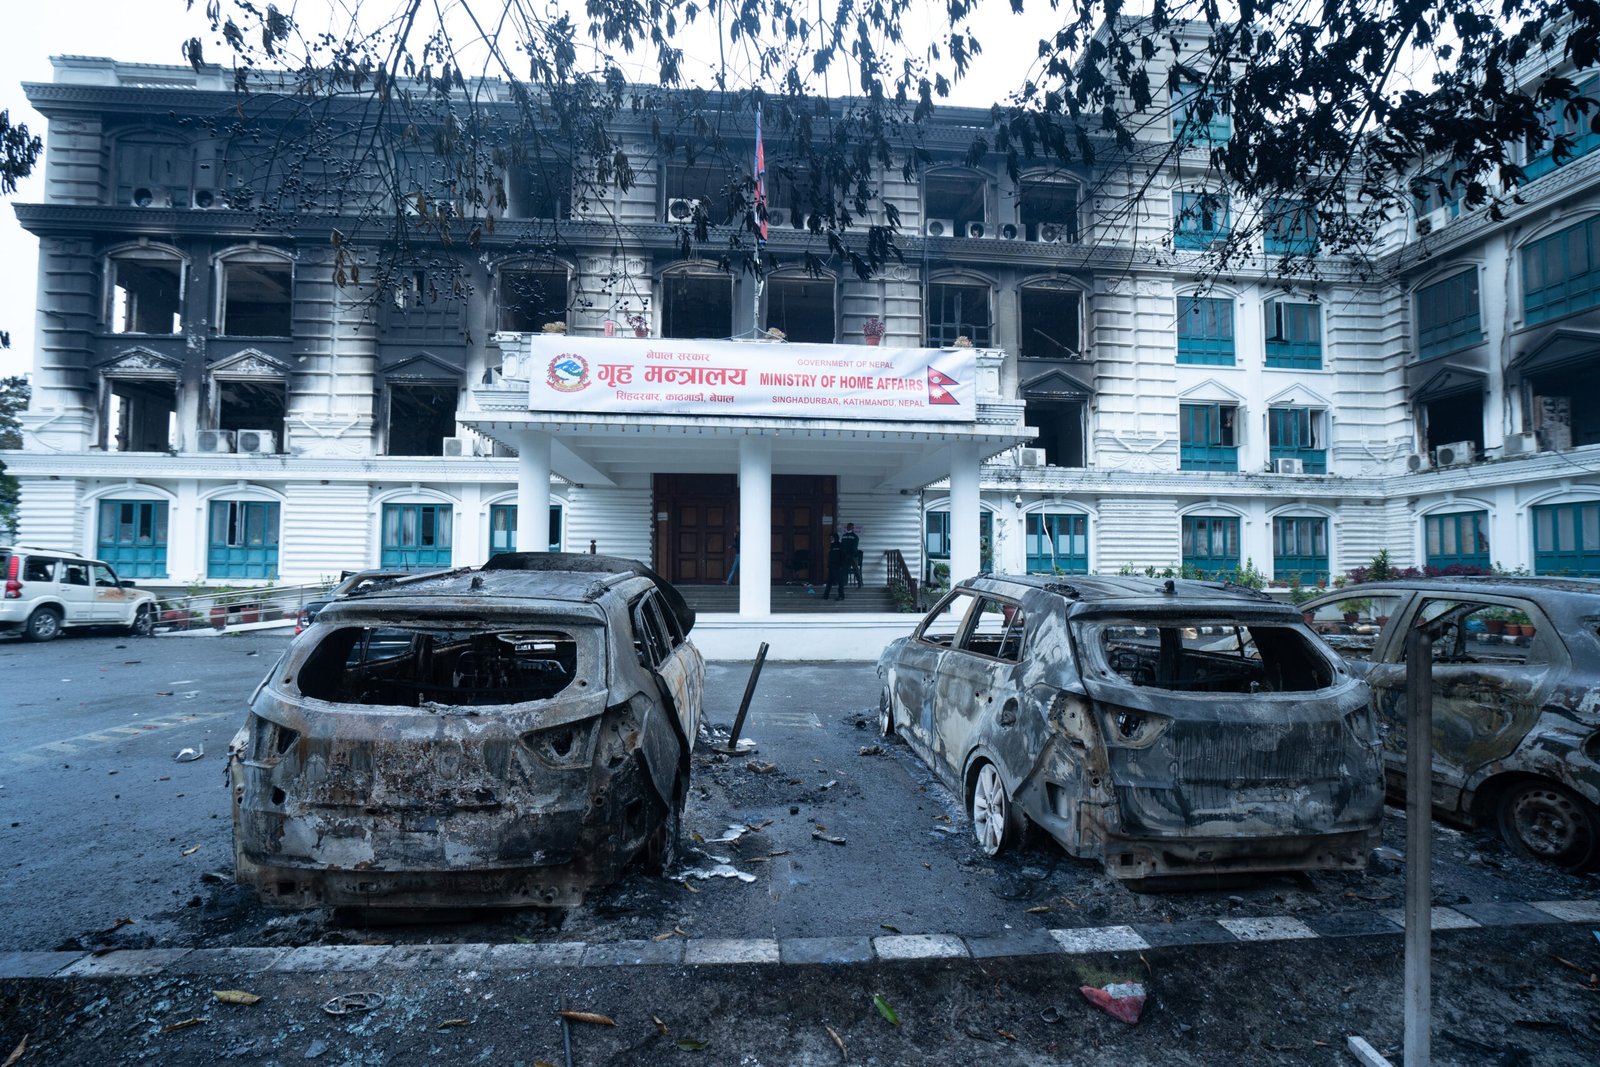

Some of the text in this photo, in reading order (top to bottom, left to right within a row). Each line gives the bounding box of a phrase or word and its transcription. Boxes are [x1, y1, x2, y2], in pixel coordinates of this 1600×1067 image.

[646, 349, 711, 361] नेपाल सरकार
[797, 359, 854, 368] GOVERNMENT
[597, 364, 748, 387] गृह मन्त्रालय
[760, 373, 923, 391] MINISTRY OF HOME AFFAIRS
[709, 393, 735, 404] नेपाल
[772, 395, 842, 406] SINGHADURBAR,
[843, 398, 896, 407] KATHMANDU,
